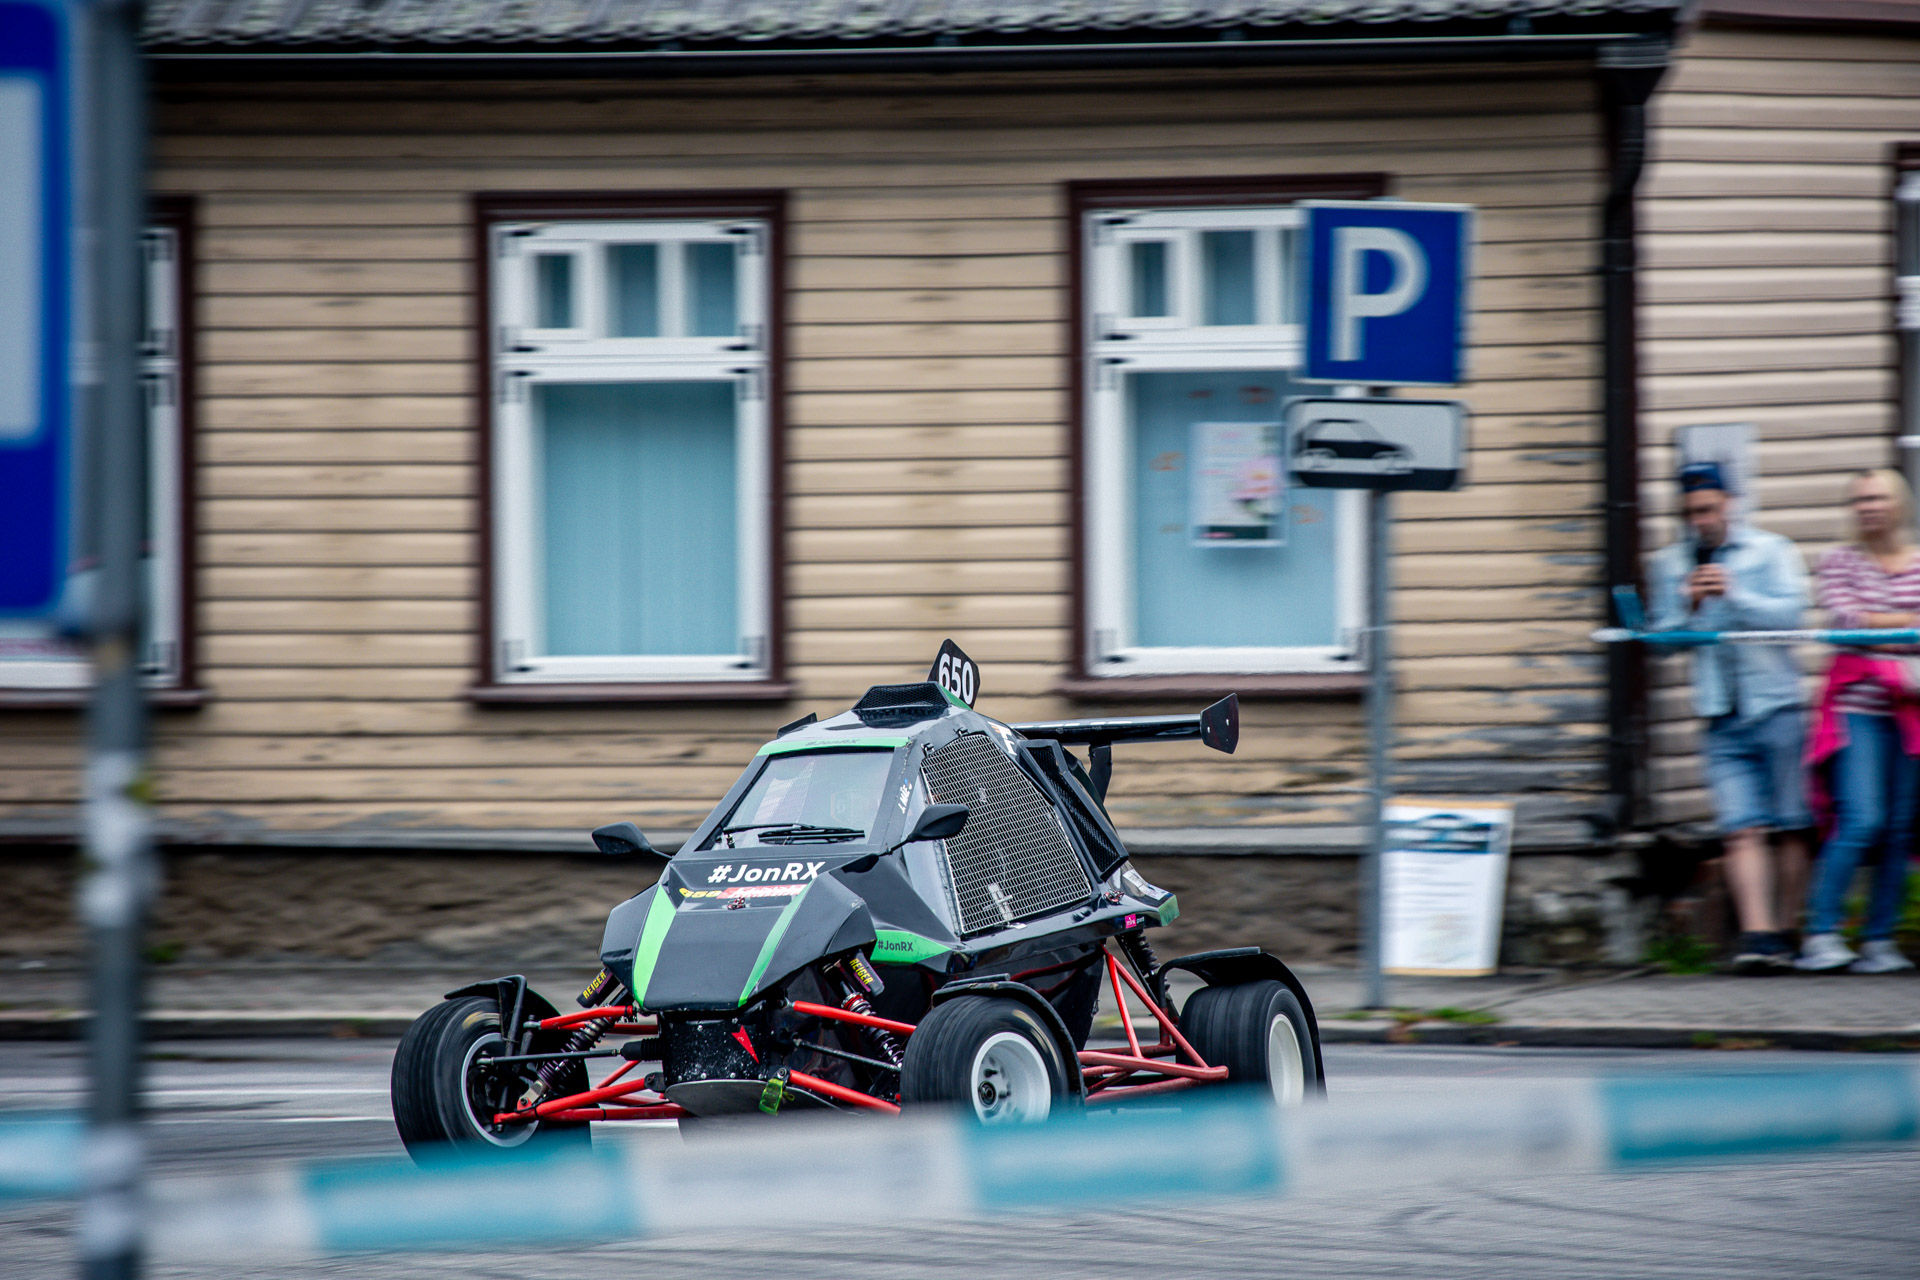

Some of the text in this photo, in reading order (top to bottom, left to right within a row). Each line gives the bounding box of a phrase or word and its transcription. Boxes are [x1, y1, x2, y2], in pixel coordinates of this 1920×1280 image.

[1327, 226, 1431, 361] P
[938, 652, 974, 705] 650
[707, 861, 826, 884] #JonRX
[877, 939, 914, 951] #JonRX
[582, 971, 607, 999] REIGER
[849, 958, 874, 985] REIGER
